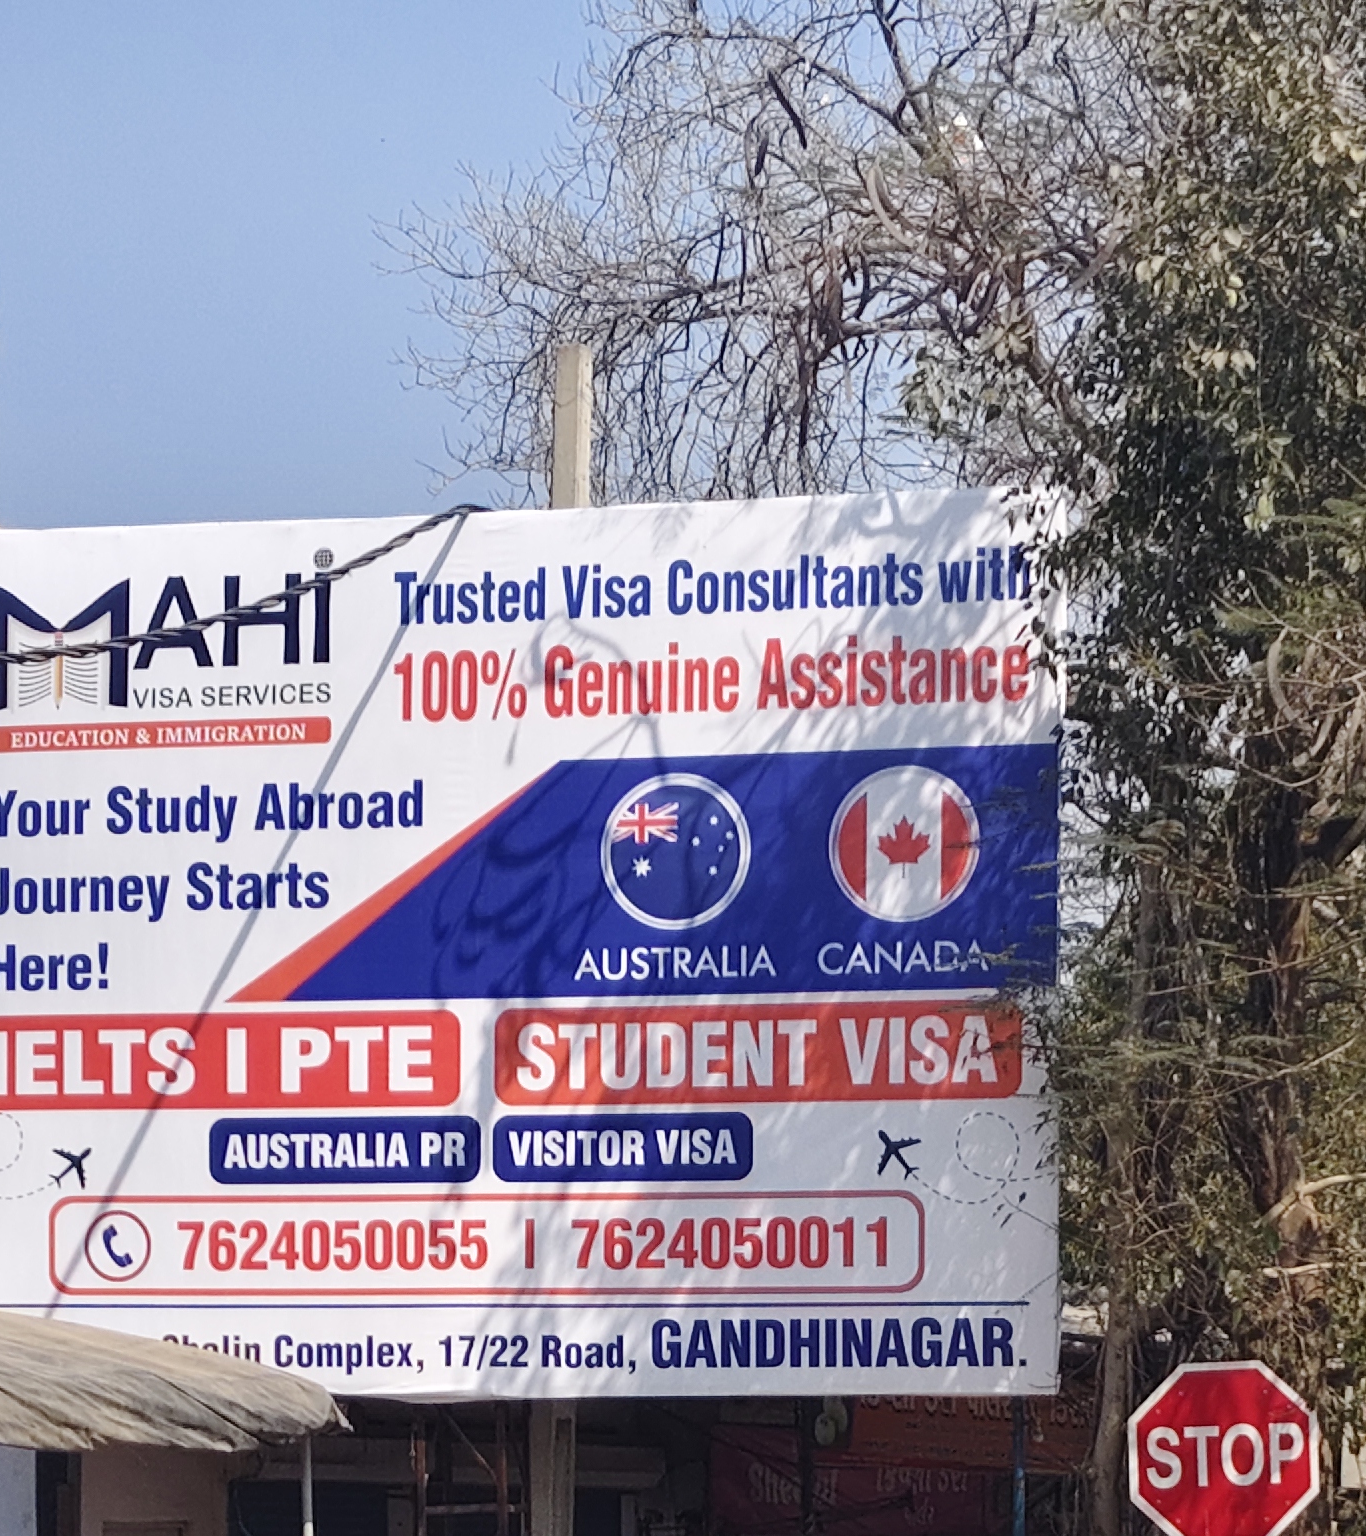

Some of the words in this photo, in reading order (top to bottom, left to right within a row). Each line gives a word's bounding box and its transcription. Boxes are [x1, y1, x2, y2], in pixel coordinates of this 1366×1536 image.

[394, 565, 547, 626] Trusted
[562, 562, 653, 620] Visa
[666, 552, 923, 616] Consultants
[938, 545, 1031, 603] with
[134, 688, 193, 710] VISA
[201, 682, 332, 707] SERVICES
[393, 647, 528, 724] 100%
[544, 642, 740, 719] Genuine
[756, 635, 1029, 712] Assistance
[11, 728, 129, 749] EDUCATION
[135, 727, 151, 746] &
[156, 722, 306, 746] IMMIGRATION
[107, 785, 238, 843] Study
[254, 779, 424, 831] Abroad
[187, 861, 330, 911] Starts
[574, 944, 776, 981] AUSTRALIA
[817, 939, 991, 976] CANADA
[280, 1024, 434, 1095] PTE
[516, 1018, 817, 1093] STUDENT
[840, 1014, 998, 1086] VISA
[224, 1132, 409, 1170] AUSTRALIA
[421, 1131, 466, 1167] PR
[508, 1130, 644, 1167] VISITOR
[656, 1129, 737, 1165] VISA
[177, 1219, 488, 1271] 7624050055
[571, 1215, 888, 1271] 7624050011
[162, 1333, 261, 1365] lin
[274, 1334, 425, 1375] Complex,
[439, 1334, 528, 1371] 17/22
[541, 1334, 637, 1375] Road,
[651, 1317, 1028, 1369] GANDHINAGAR.
[1145, 1423, 1304, 1490] STOP
